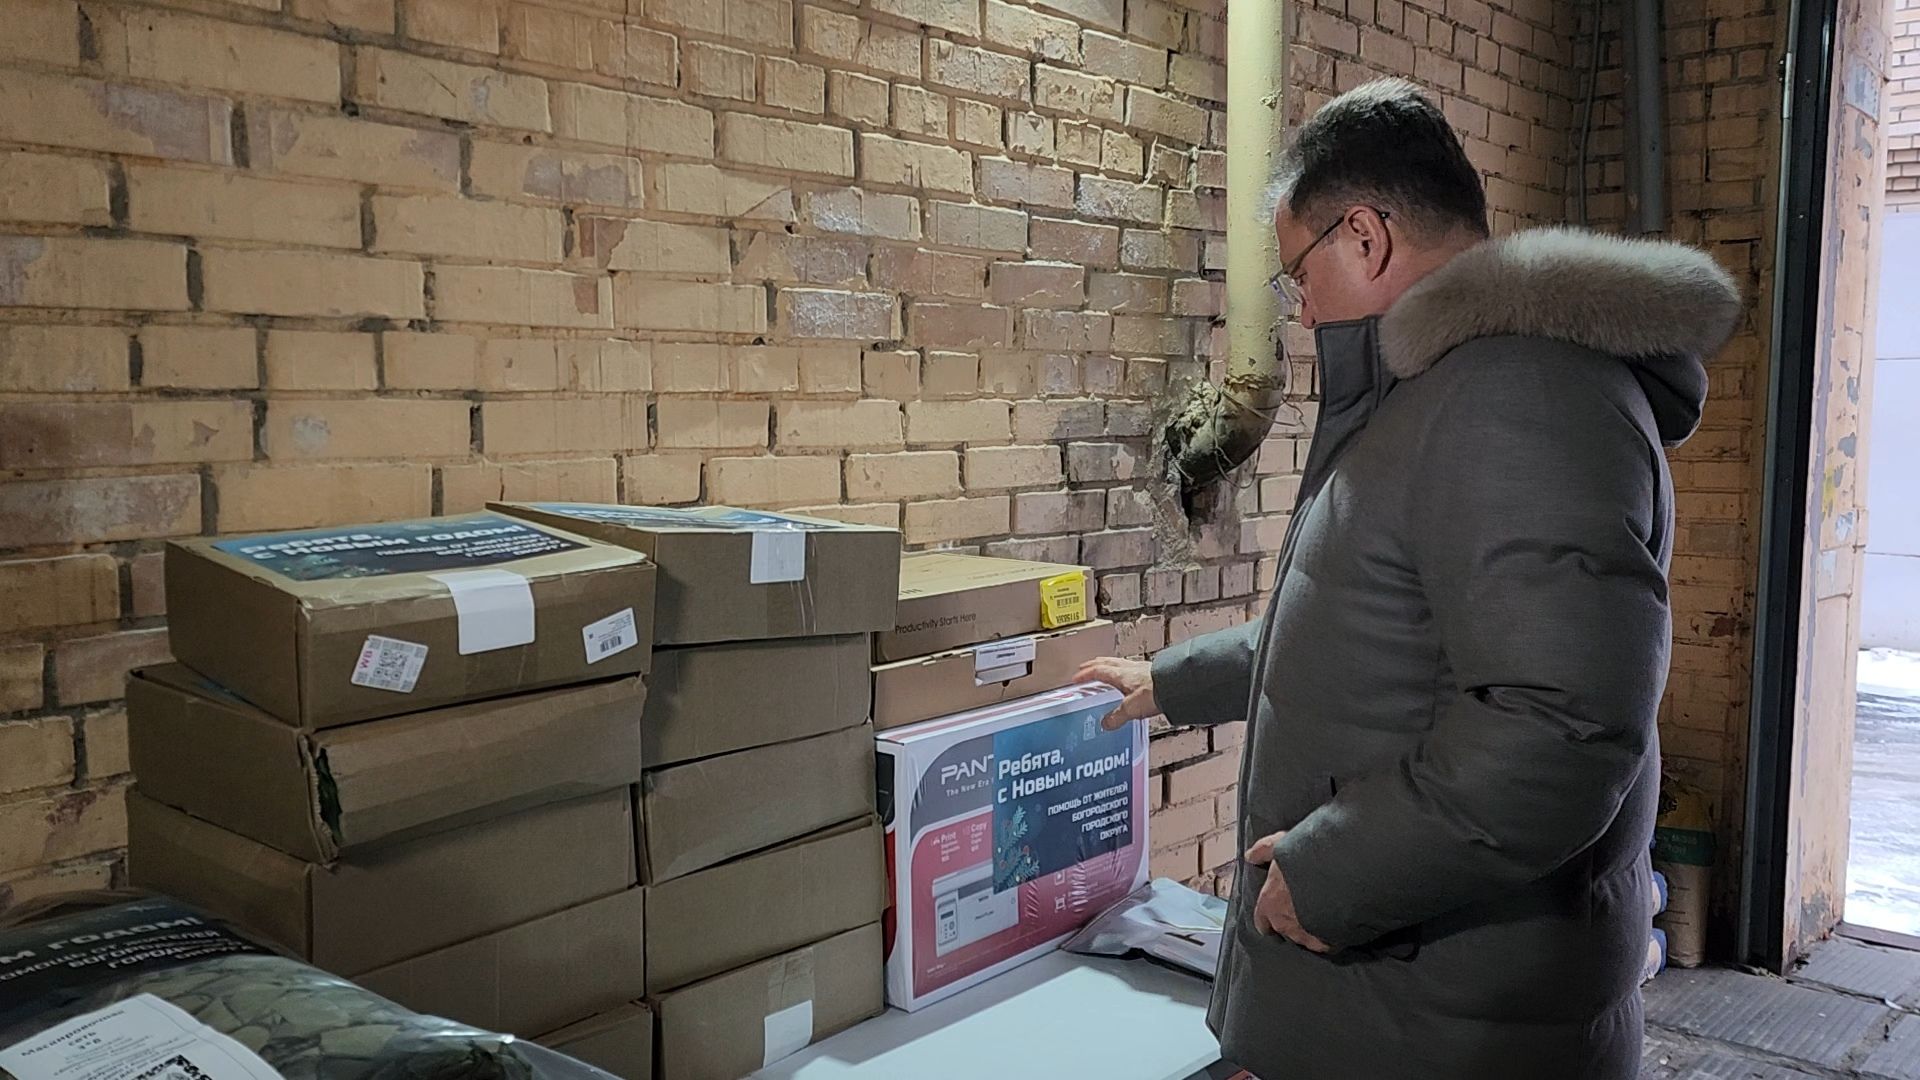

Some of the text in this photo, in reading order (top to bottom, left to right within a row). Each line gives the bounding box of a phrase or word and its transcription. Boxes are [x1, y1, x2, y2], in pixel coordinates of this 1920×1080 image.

[997, 747, 1130, 804] с Новым годом!
[998, 748, 1065, 781] Ребята,
[946, 788, 959, 797] The
[961, 783, 976, 793] New
[1048, 781, 1128, 817] ПОМОЩЬ ОТ ЖИТЕЛЕЙ
[1071, 796, 1128, 823] БОГОРОДСКОГО
[1081, 810, 1128, 833] ГОРОДСКОГО
[1099, 824, 1128, 841] ОКРУГА
[48, 916, 205, 951] годом!
